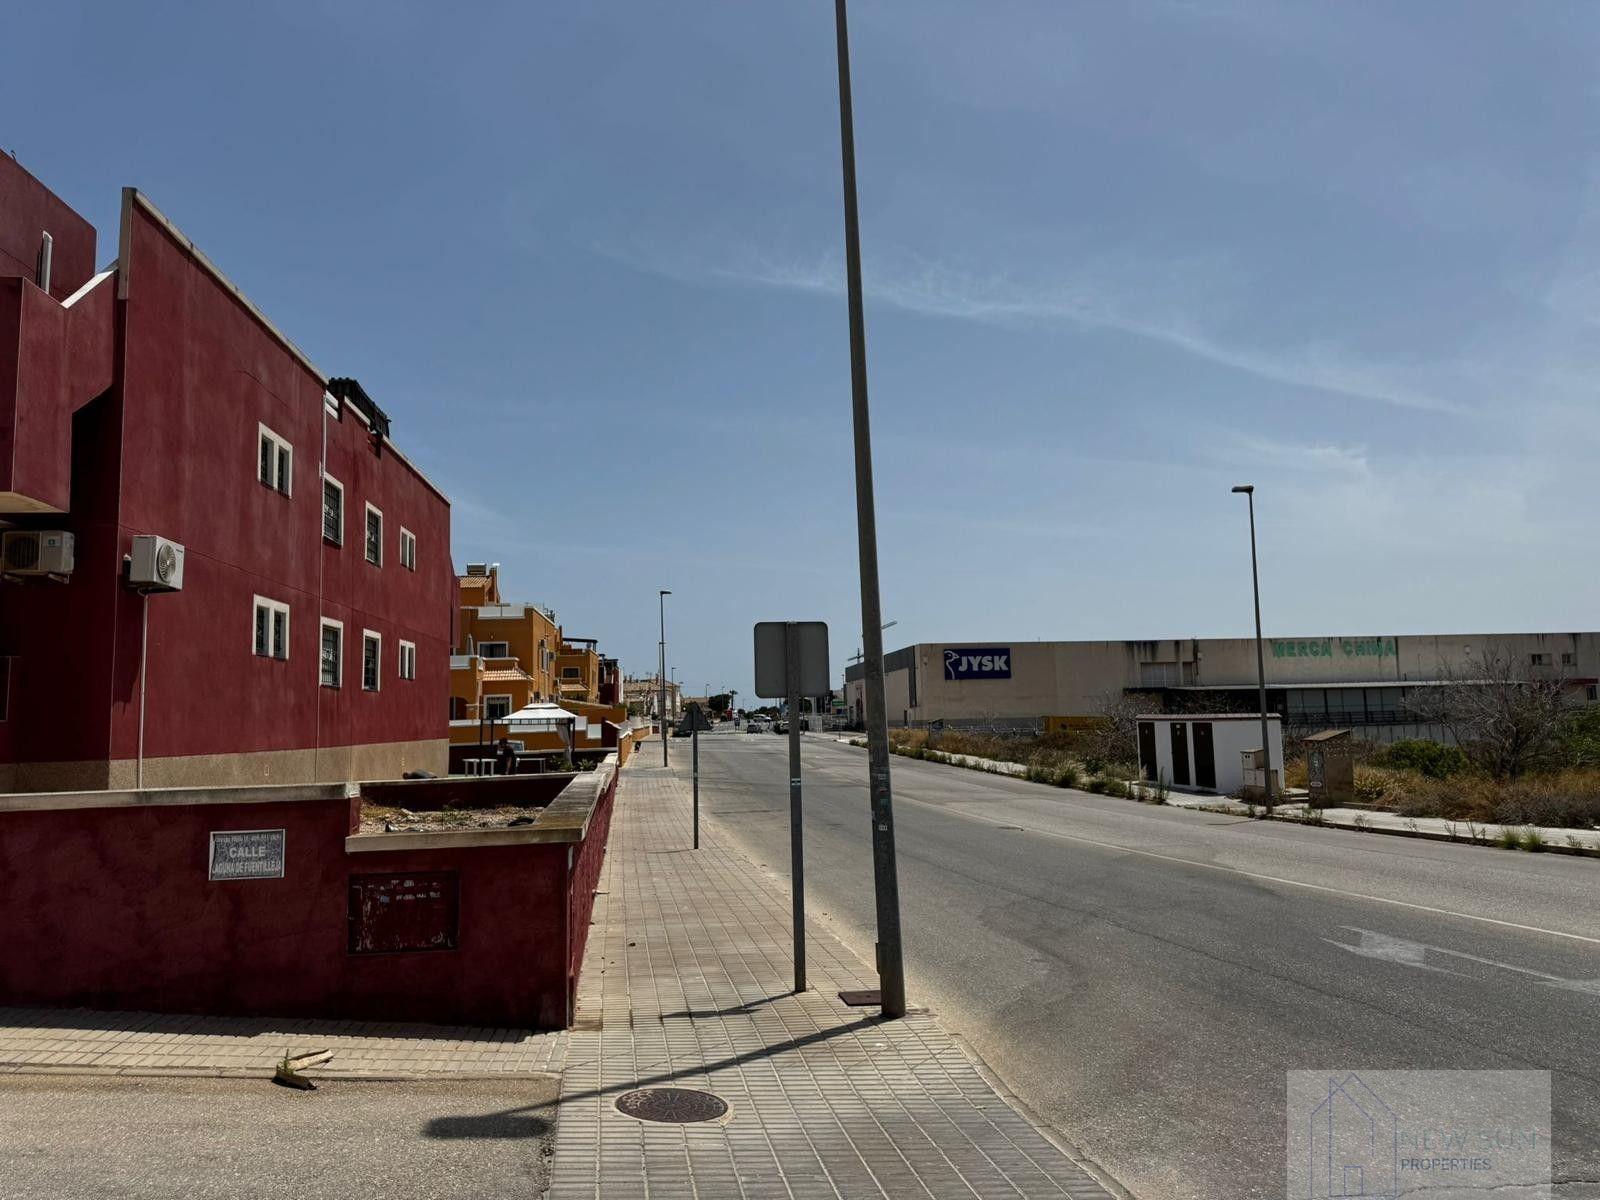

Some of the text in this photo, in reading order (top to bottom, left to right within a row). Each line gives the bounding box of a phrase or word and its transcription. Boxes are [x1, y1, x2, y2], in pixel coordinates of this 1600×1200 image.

[1271, 640, 1397, 657] MERCA CHINA
[959, 655, 1008, 672] JYSK
[229, 846, 266, 858] CALLE
[235, 862, 244, 873] DE
